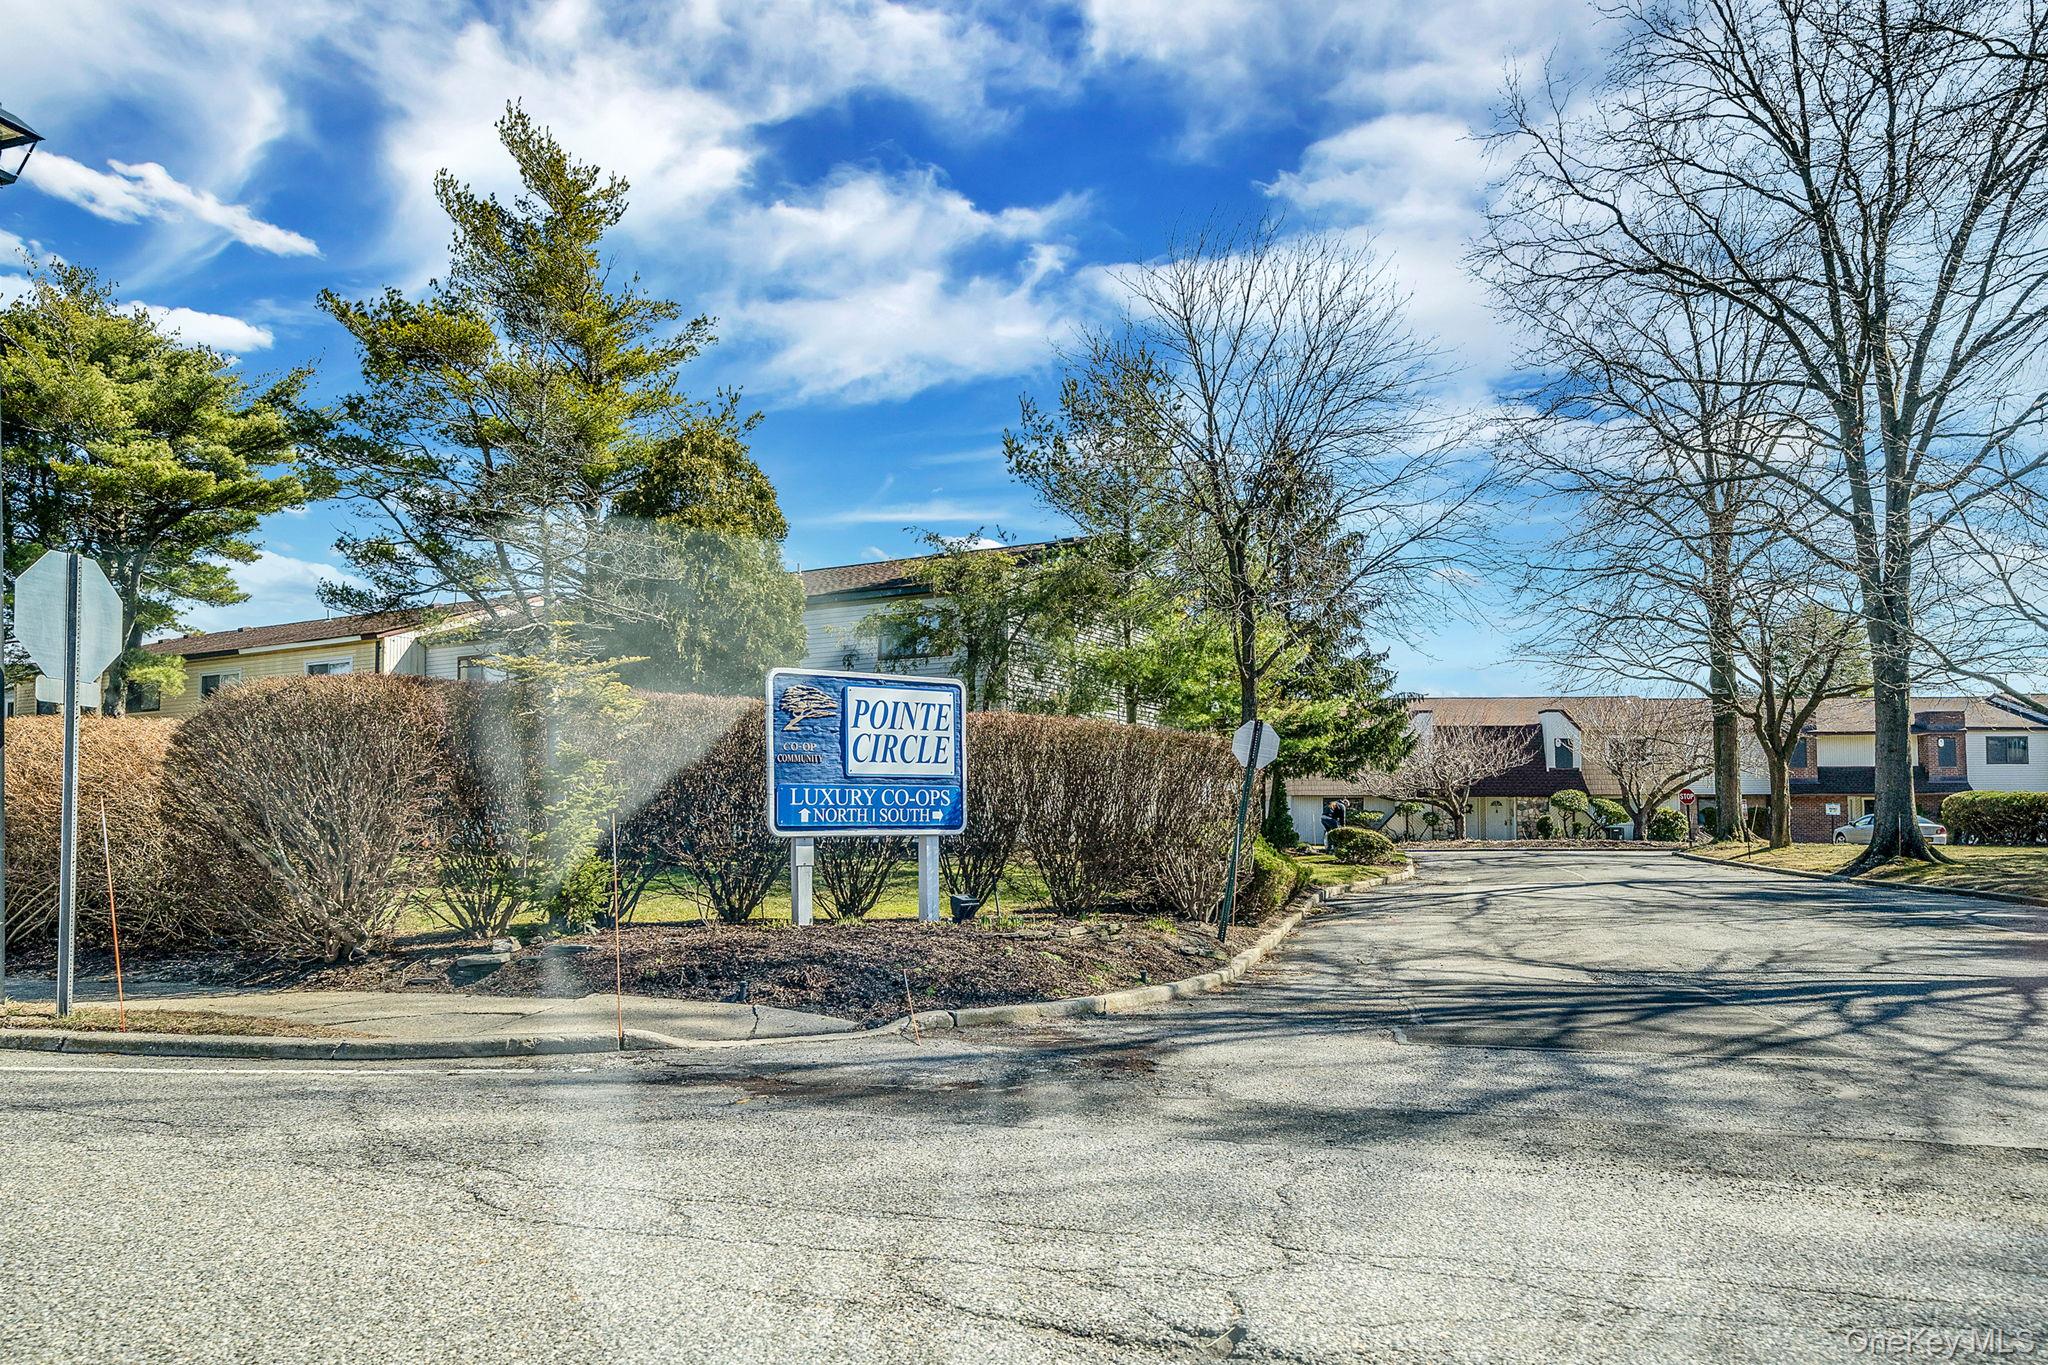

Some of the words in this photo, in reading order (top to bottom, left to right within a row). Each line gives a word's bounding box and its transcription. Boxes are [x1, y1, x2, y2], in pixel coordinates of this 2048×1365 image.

[851, 700, 950, 731] POINTE
[783, 742, 817, 751] CO-OP
[852, 733, 950, 764] CIRCLE
[777, 754, 823, 763] COMMUNITY
[790, 788, 876, 806] LUXURY
[881, 789, 950, 806] CO-OPS
[813, 808, 867, 823] NORTH
[879, 808, 930, 823] SOUTH
